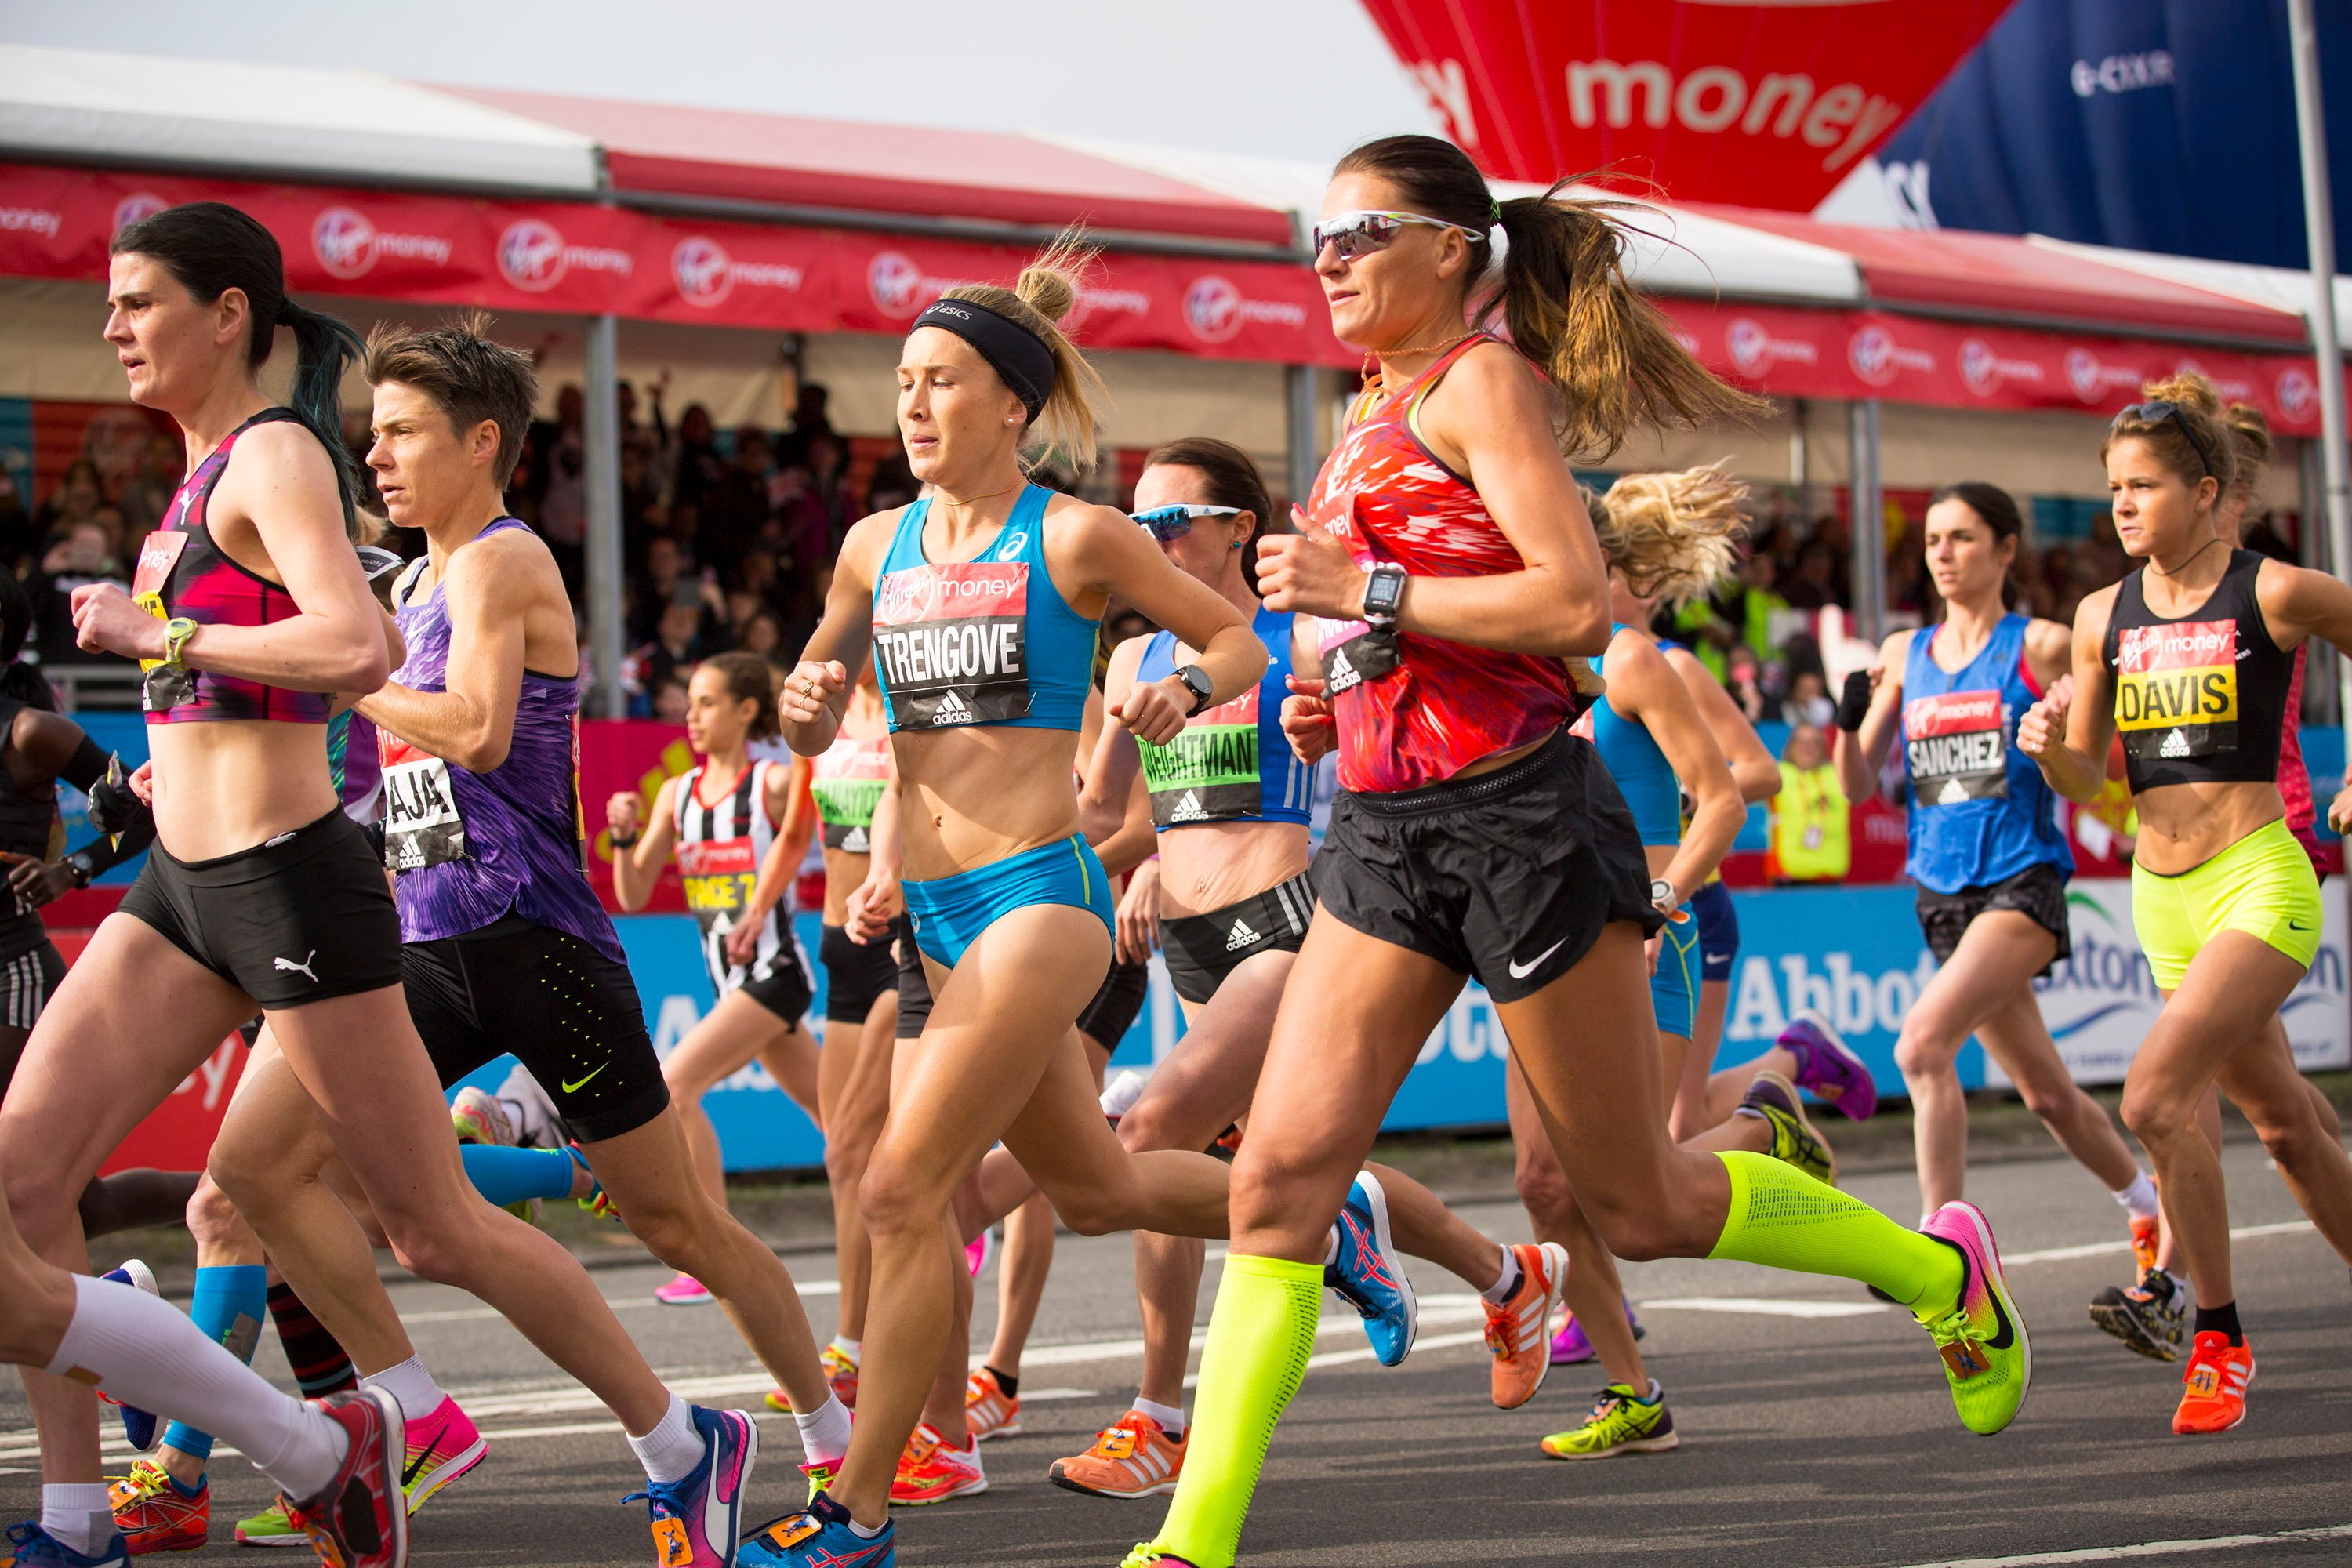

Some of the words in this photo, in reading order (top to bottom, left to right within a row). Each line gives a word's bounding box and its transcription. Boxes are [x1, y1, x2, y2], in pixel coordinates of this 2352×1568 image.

[1566, 58, 1903, 174] money
[0, 208, 62, 239] oney
[376, 233, 453, 266] money
[938, 305, 973, 321] asics
[937, 579, 1021, 600] money
[877, 622, 1020, 685] TRENGOVE
[2165, 633, 2230, 654] money
[1330, 669, 1362, 693] adidas
[1938, 700, 1996, 720] money
[2121, 673, 2230, 723] DAVIS
[932, 710, 973, 726] adidas
[1907, 730, 2003, 779] SANCHEZ
[1171, 811, 1210, 823] adidas
[398, 855, 426, 869] adidas
[683, 874, 739, 910] PACE
[1225, 931, 1262, 952] adidas
[1727, 949, 1940, 1042] Abbo
